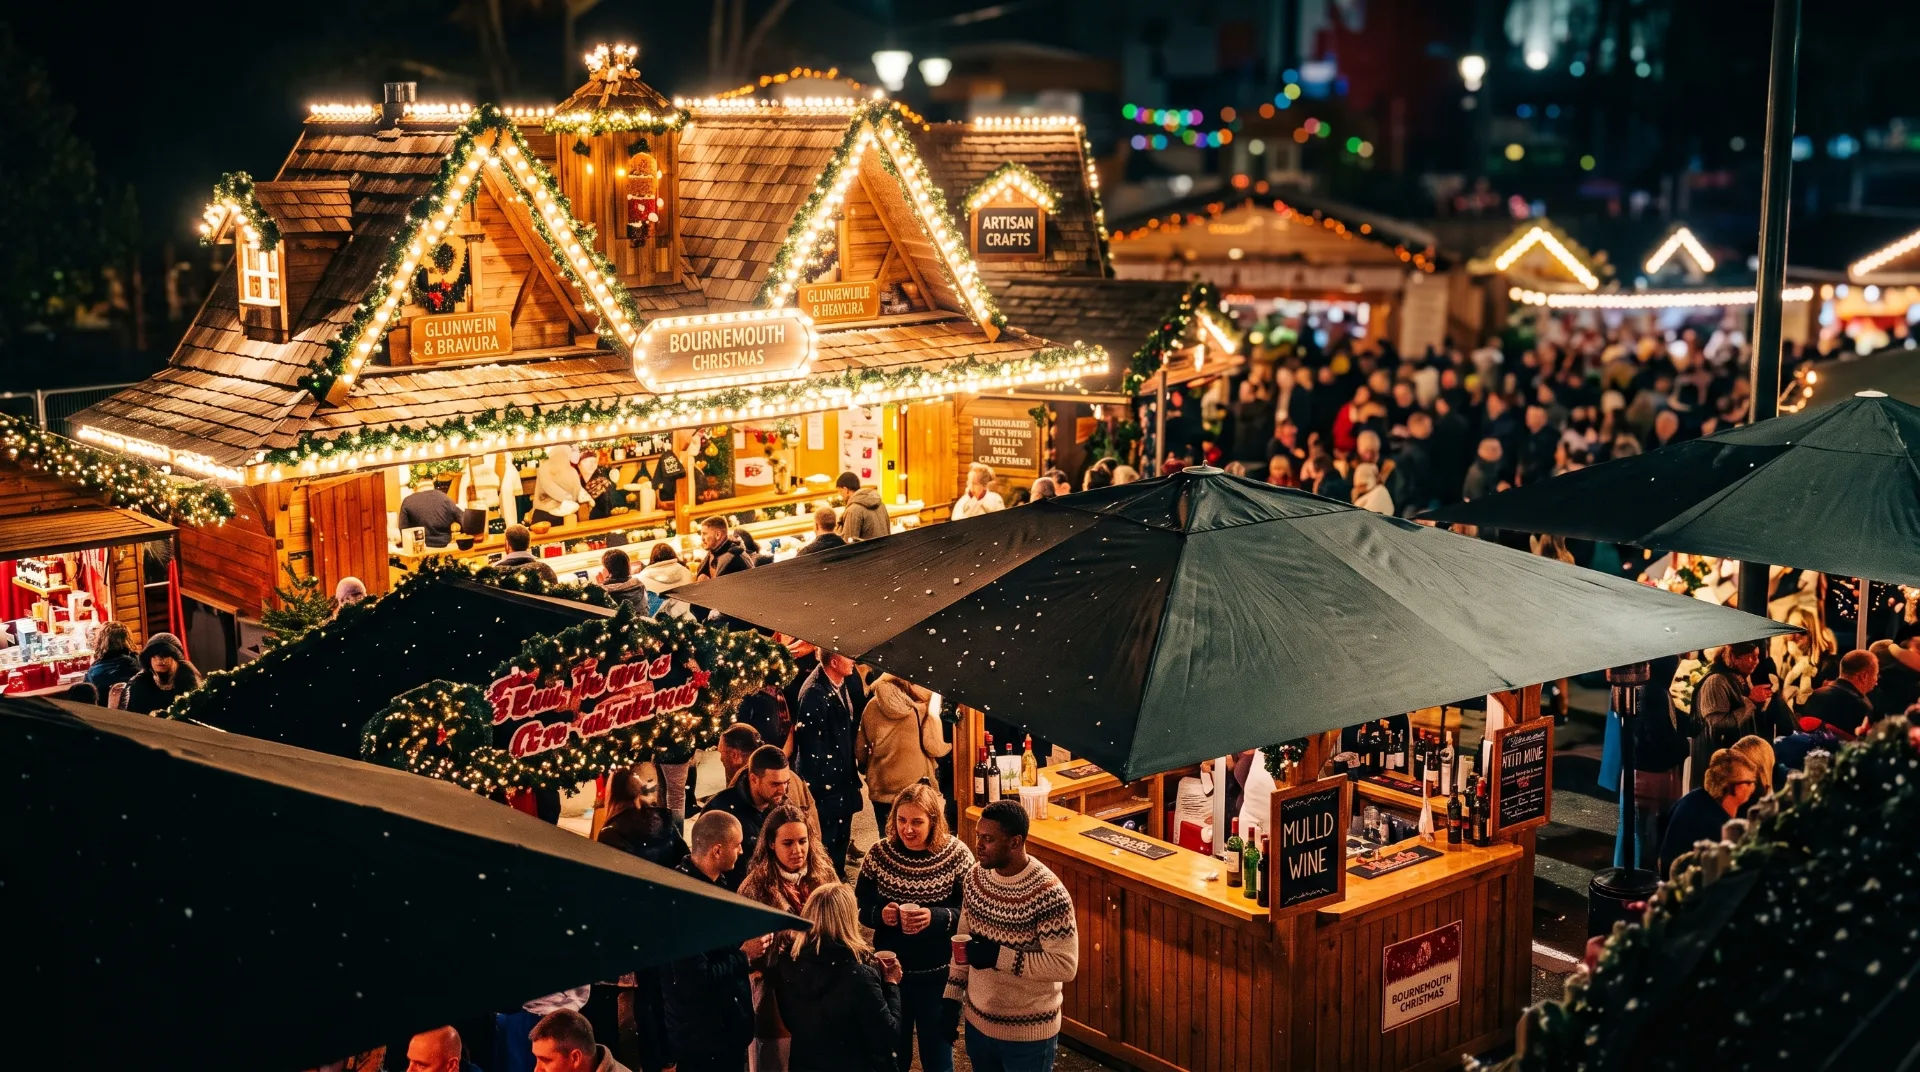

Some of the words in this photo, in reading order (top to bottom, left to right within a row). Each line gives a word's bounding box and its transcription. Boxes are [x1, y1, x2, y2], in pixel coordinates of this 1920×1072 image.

[982, 215, 1034, 230] ARTISAN
[985, 232, 1031, 247] CRAFTS
[425, 317, 497, 338] GLUNWEIN
[423, 340, 433, 356] &
[437, 335, 499, 355] BRAVURA
[670, 325, 784, 353] BOURNEMOUTH
[692, 350, 764, 371] CHRISTMAS
[978, 455, 1032, 466] CRAFTSMEN
[1283, 812, 1334, 848] MULLD
[1288, 846, 1328, 881] WINE
[1392, 973, 1452, 1005] BOURNEMOUTH
[1400, 987, 1444, 1013] CHRISTMAS
